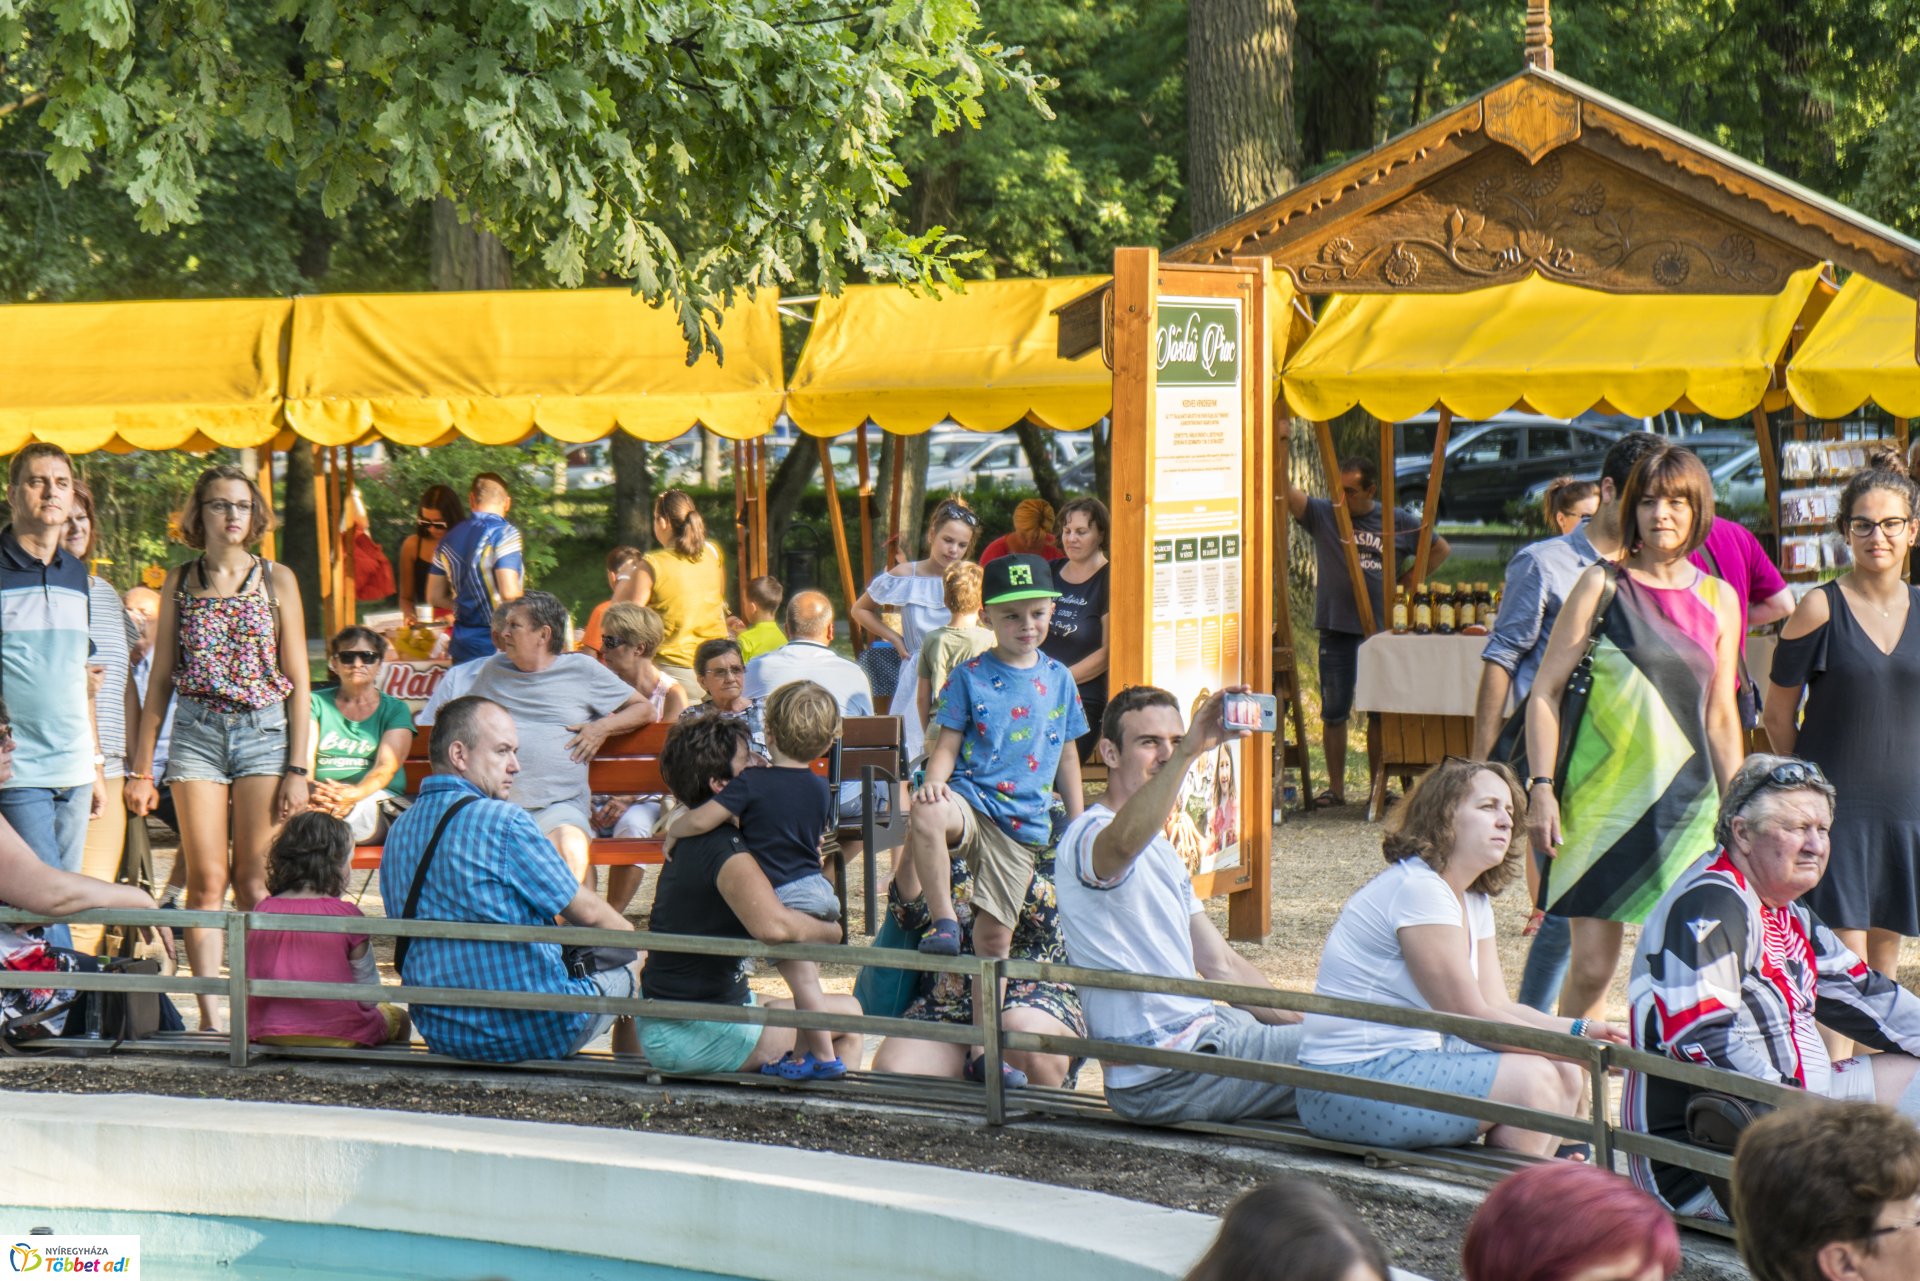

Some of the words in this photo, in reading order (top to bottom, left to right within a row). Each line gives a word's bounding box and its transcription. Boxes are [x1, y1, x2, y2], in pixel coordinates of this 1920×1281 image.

[1156, 312, 1201, 370] Sóstói
[1202, 323, 1236, 377] Piac
[386, 666, 444, 697] Hat
